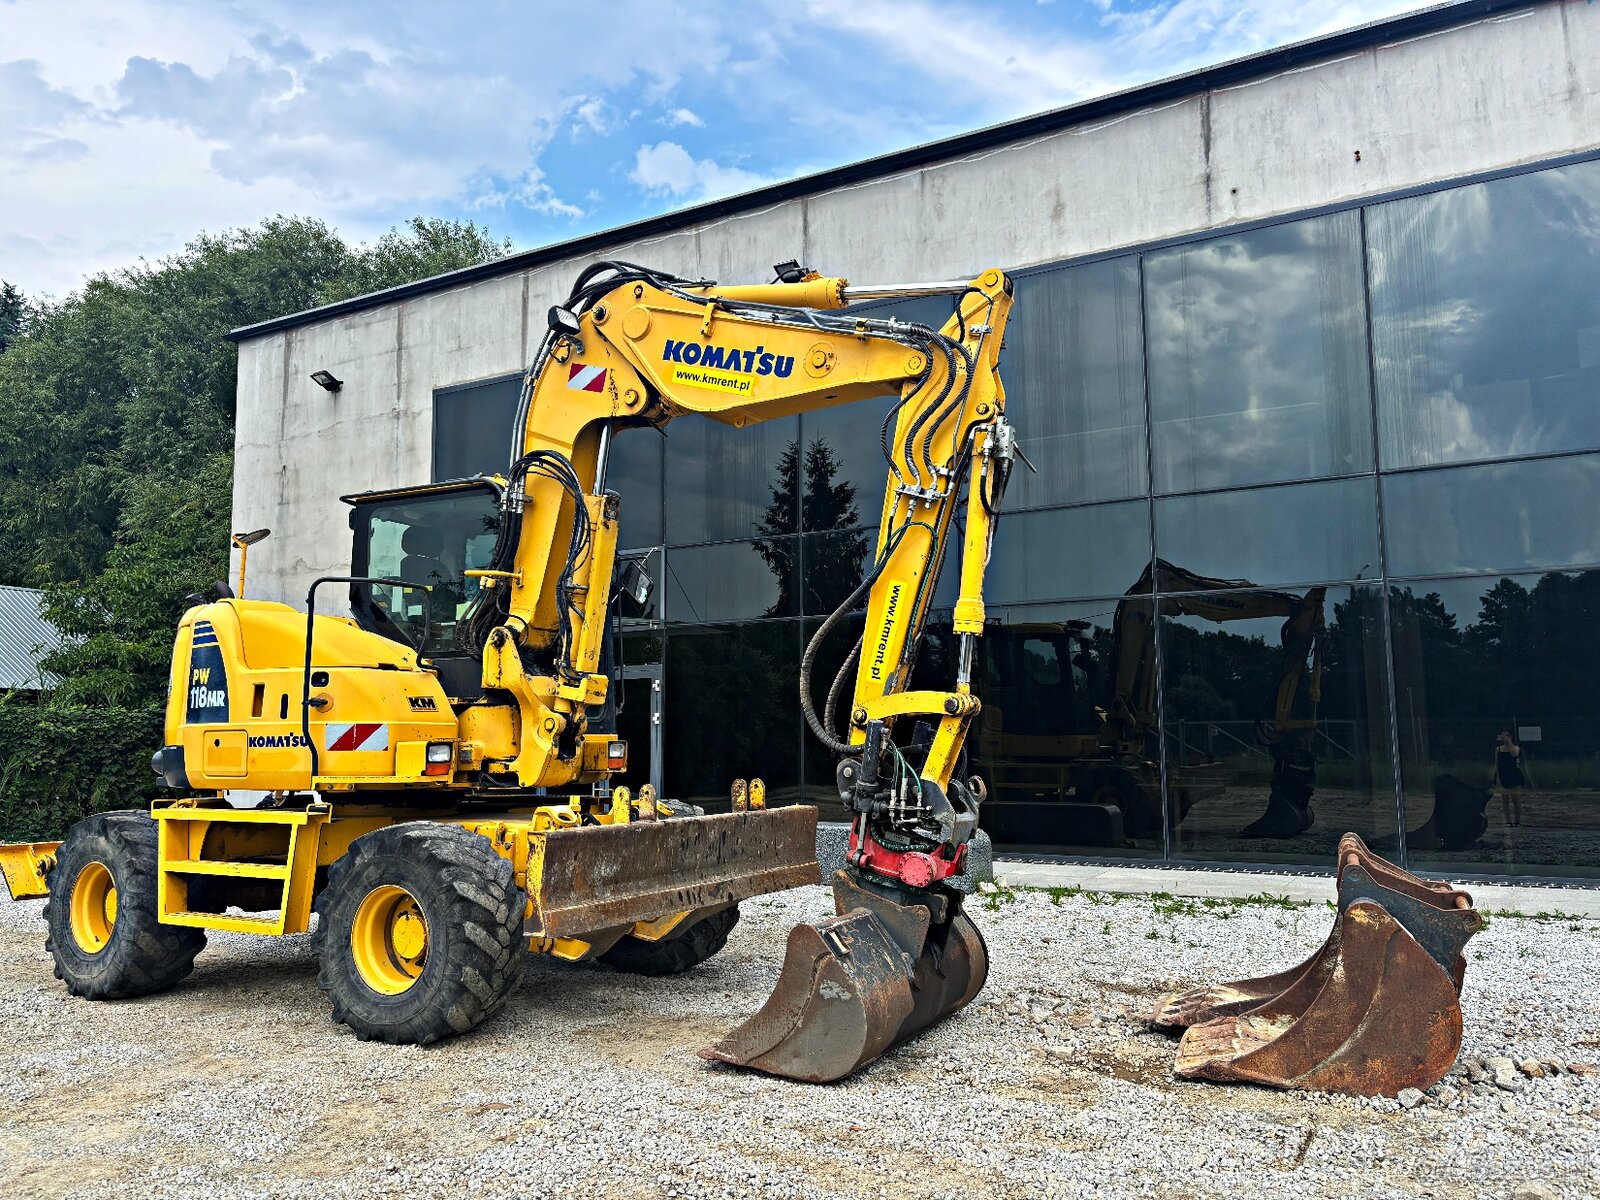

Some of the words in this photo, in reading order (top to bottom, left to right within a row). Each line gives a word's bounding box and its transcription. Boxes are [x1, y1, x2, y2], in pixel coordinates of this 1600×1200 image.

[663, 340, 795, 379] KOMATSU
[676, 370, 751, 391] www.kmrent.pl
[871, 585, 902, 680] www.kmrent.pl
[192, 668, 211, 685] PW
[408, 697, 436, 709] KM
